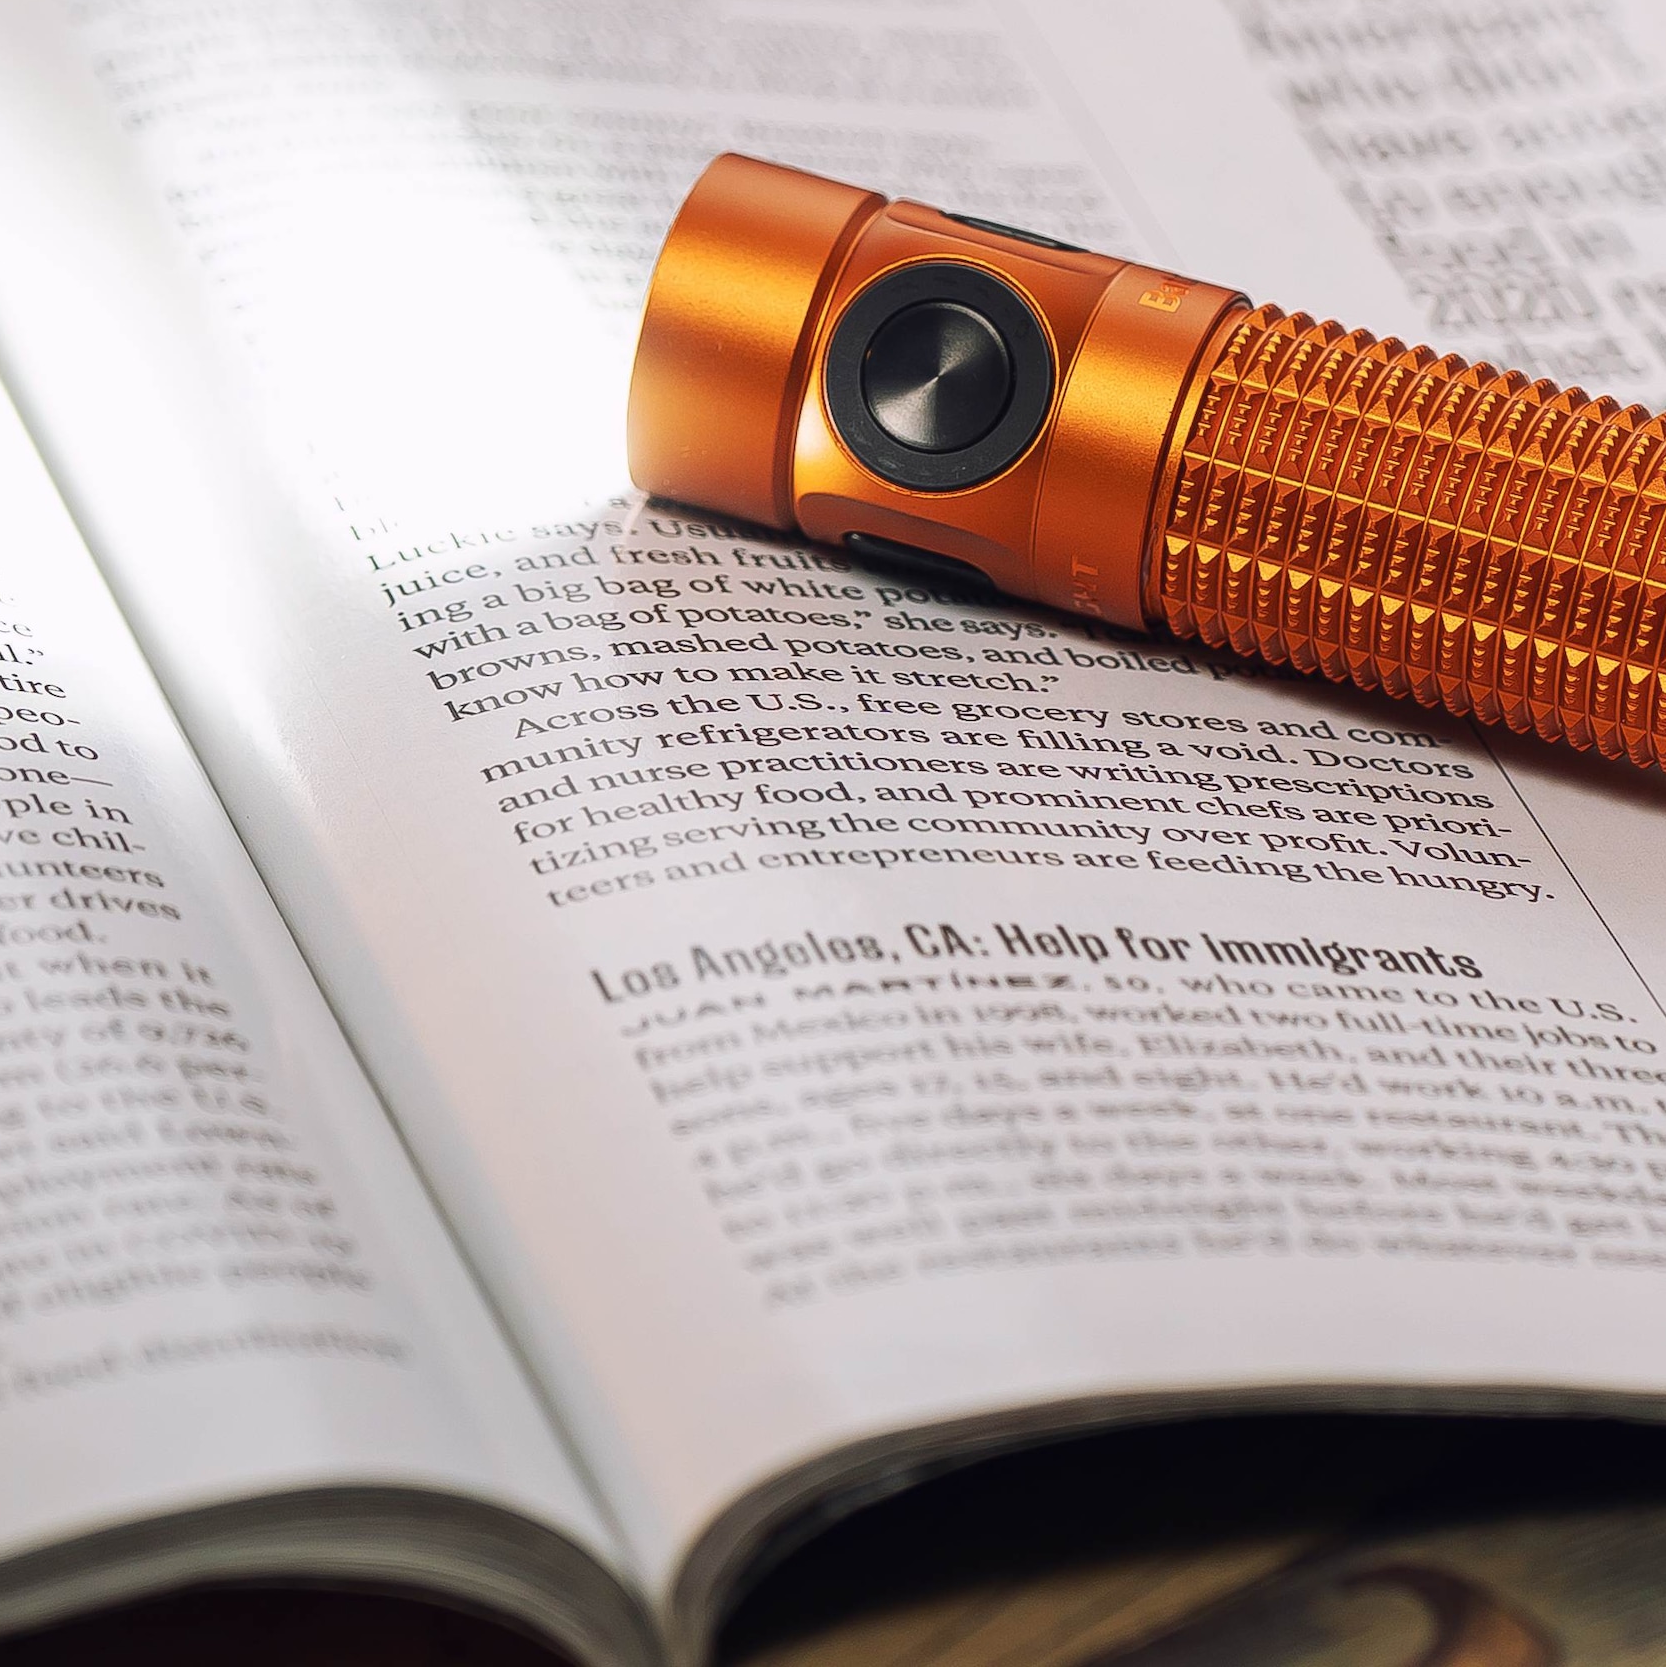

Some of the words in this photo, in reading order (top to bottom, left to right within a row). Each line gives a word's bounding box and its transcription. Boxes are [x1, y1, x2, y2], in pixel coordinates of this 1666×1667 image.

[425, 646, 601, 691] browns,
[608, 631, 779, 658] mashed
[782, 639, 975, 664] potatoes,
[981, 647, 1063, 666] and
[1063, 645, 1198, 676] boiled
[442, 681, 563, 723] know
[569, 671, 664, 693] how
[672, 667, 719, 684] to
[726, 661, 845, 682] make
[850, 665, 886, 685] it
[891, 671, 1060, 693] stretch.”
[514, 703, 660, 740] Across
[666, 694, 741, 716] the
[745, 692, 850, 714] U.S.,
[857, 692, 942, 716] free
[951, 703, 1110, 729] grocery
[1121, 711, 1249, 734] stores
[1256, 720, 1340, 741] and
[1344, 723, 1453, 748] com-
[480, 736, 643, 784] munity
[655, 723, 931, 749] refrigerators
[940, 731, 1009, 747] are
[1016, 729, 1151, 759] filling
[1156, 741, 1185, 757] a
[1187, 742, 1298, 765] void.
[1302, 748, 1475, 780] Doctors
[498, 774, 581, 814] and
[587, 763, 711, 792] nurse
[716, 751, 990, 781] practitioners
[996, 762, 1062, 778] are
[1065, 762, 1223, 793] writing
[1222, 774, 1495, 810] prescriptions
[513, 815, 573, 846] for
[580, 789, 744, 827] healthy
[754, 780, 867, 804] food,
[874, 782, 957, 803] and
[961, 789, 1191, 814] prominent
[1195, 796, 1306, 822] chefs
[1311, 808, 1378, 827] are
[1381, 812, 1512, 839] priori-
[529, 835, 659, 876] tizing
[662, 816, 827, 847] serving
[827, 811, 900, 834] the
[907, 818, 1151, 845] community
[1162, 827, 1251, 846] over
[1258, 832, 1388, 856] profit.
[1388, 838, 1532, 868] Volun-
[589, 962, 681, 1005] Los
[689, 930, 901, 982] Angeles,
[903, 923, 989, 958] CA:
[993, 923, 1110, 964] Help
[1114, 927, 1191, 962] for
[1200, 932, 1483, 979] Immigrants
